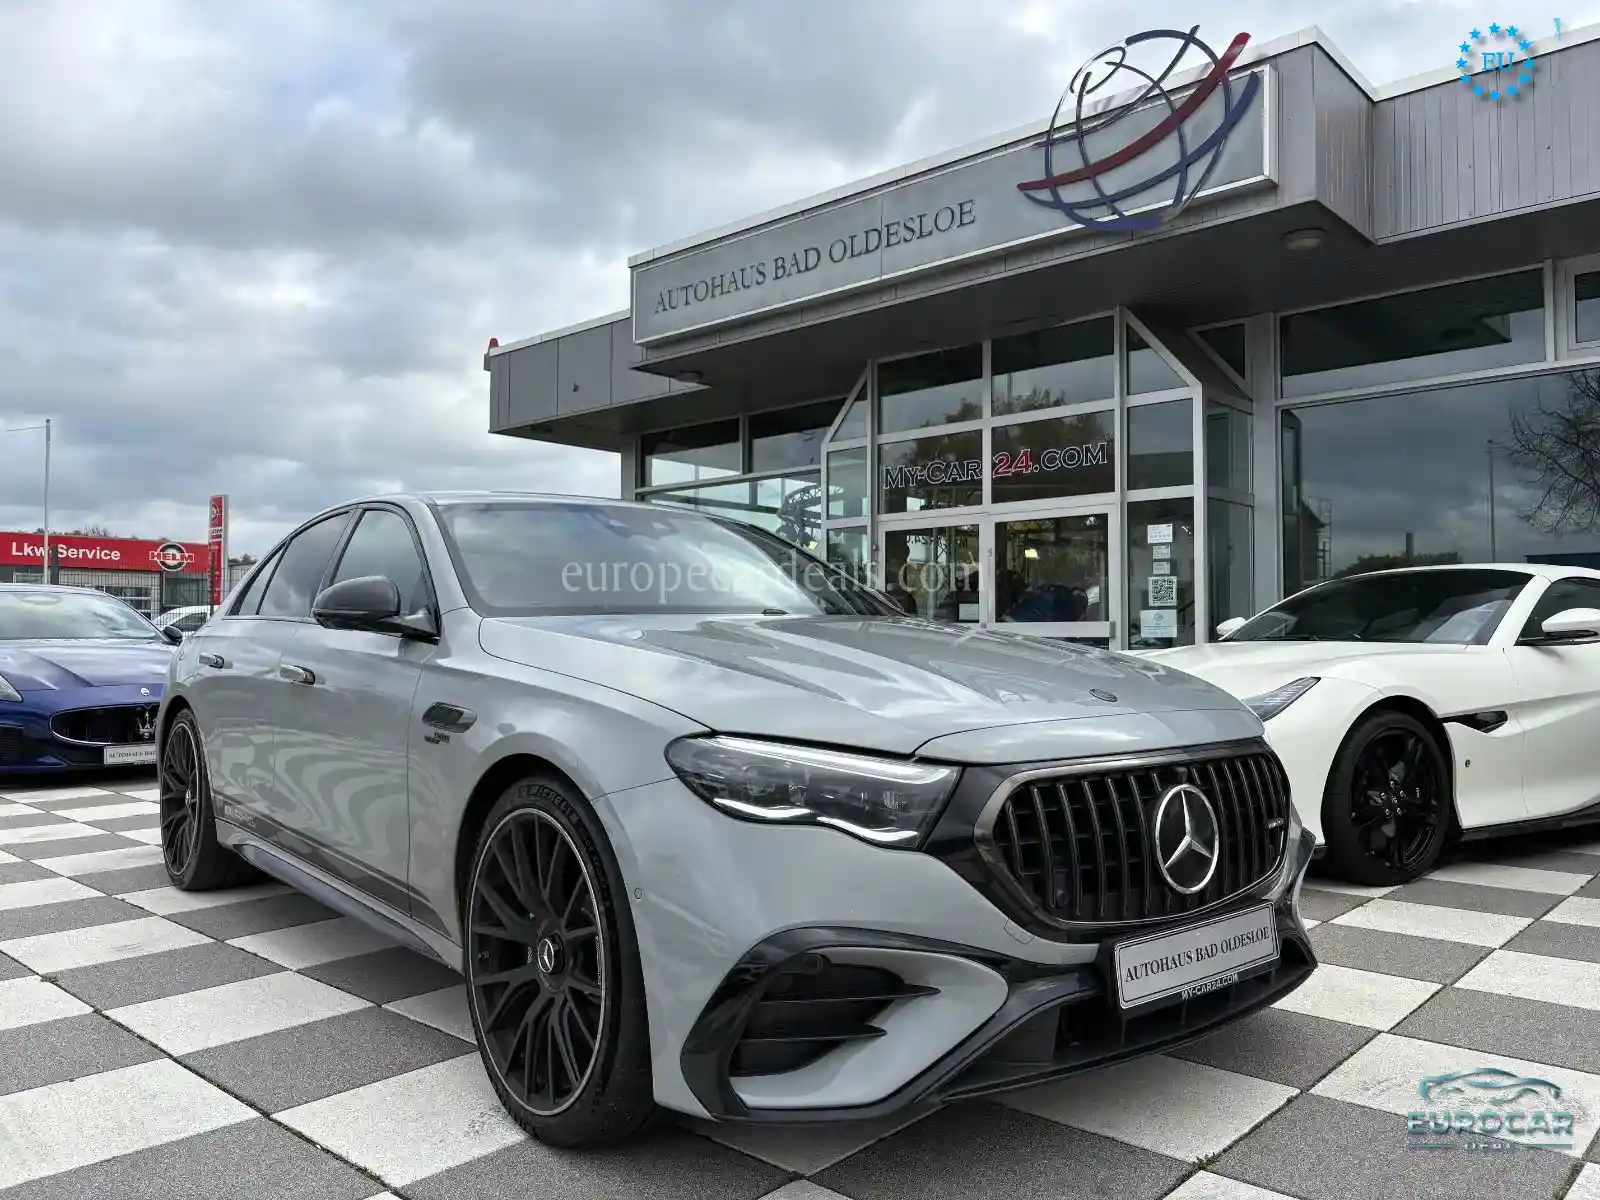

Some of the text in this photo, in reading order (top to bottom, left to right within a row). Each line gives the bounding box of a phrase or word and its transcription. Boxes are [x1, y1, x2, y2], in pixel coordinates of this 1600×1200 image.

[654, 199, 977, 314] AUTOHAUS BAD OLDESLOE
[58, 543, 121, 561] Service
[149, 551, 195, 563] HELM
[1125, 926, 1270, 983] AUTOHAUS BAD OLDESLOE
[1181, 973, 1239, 1001] MY-CAR24.COM
